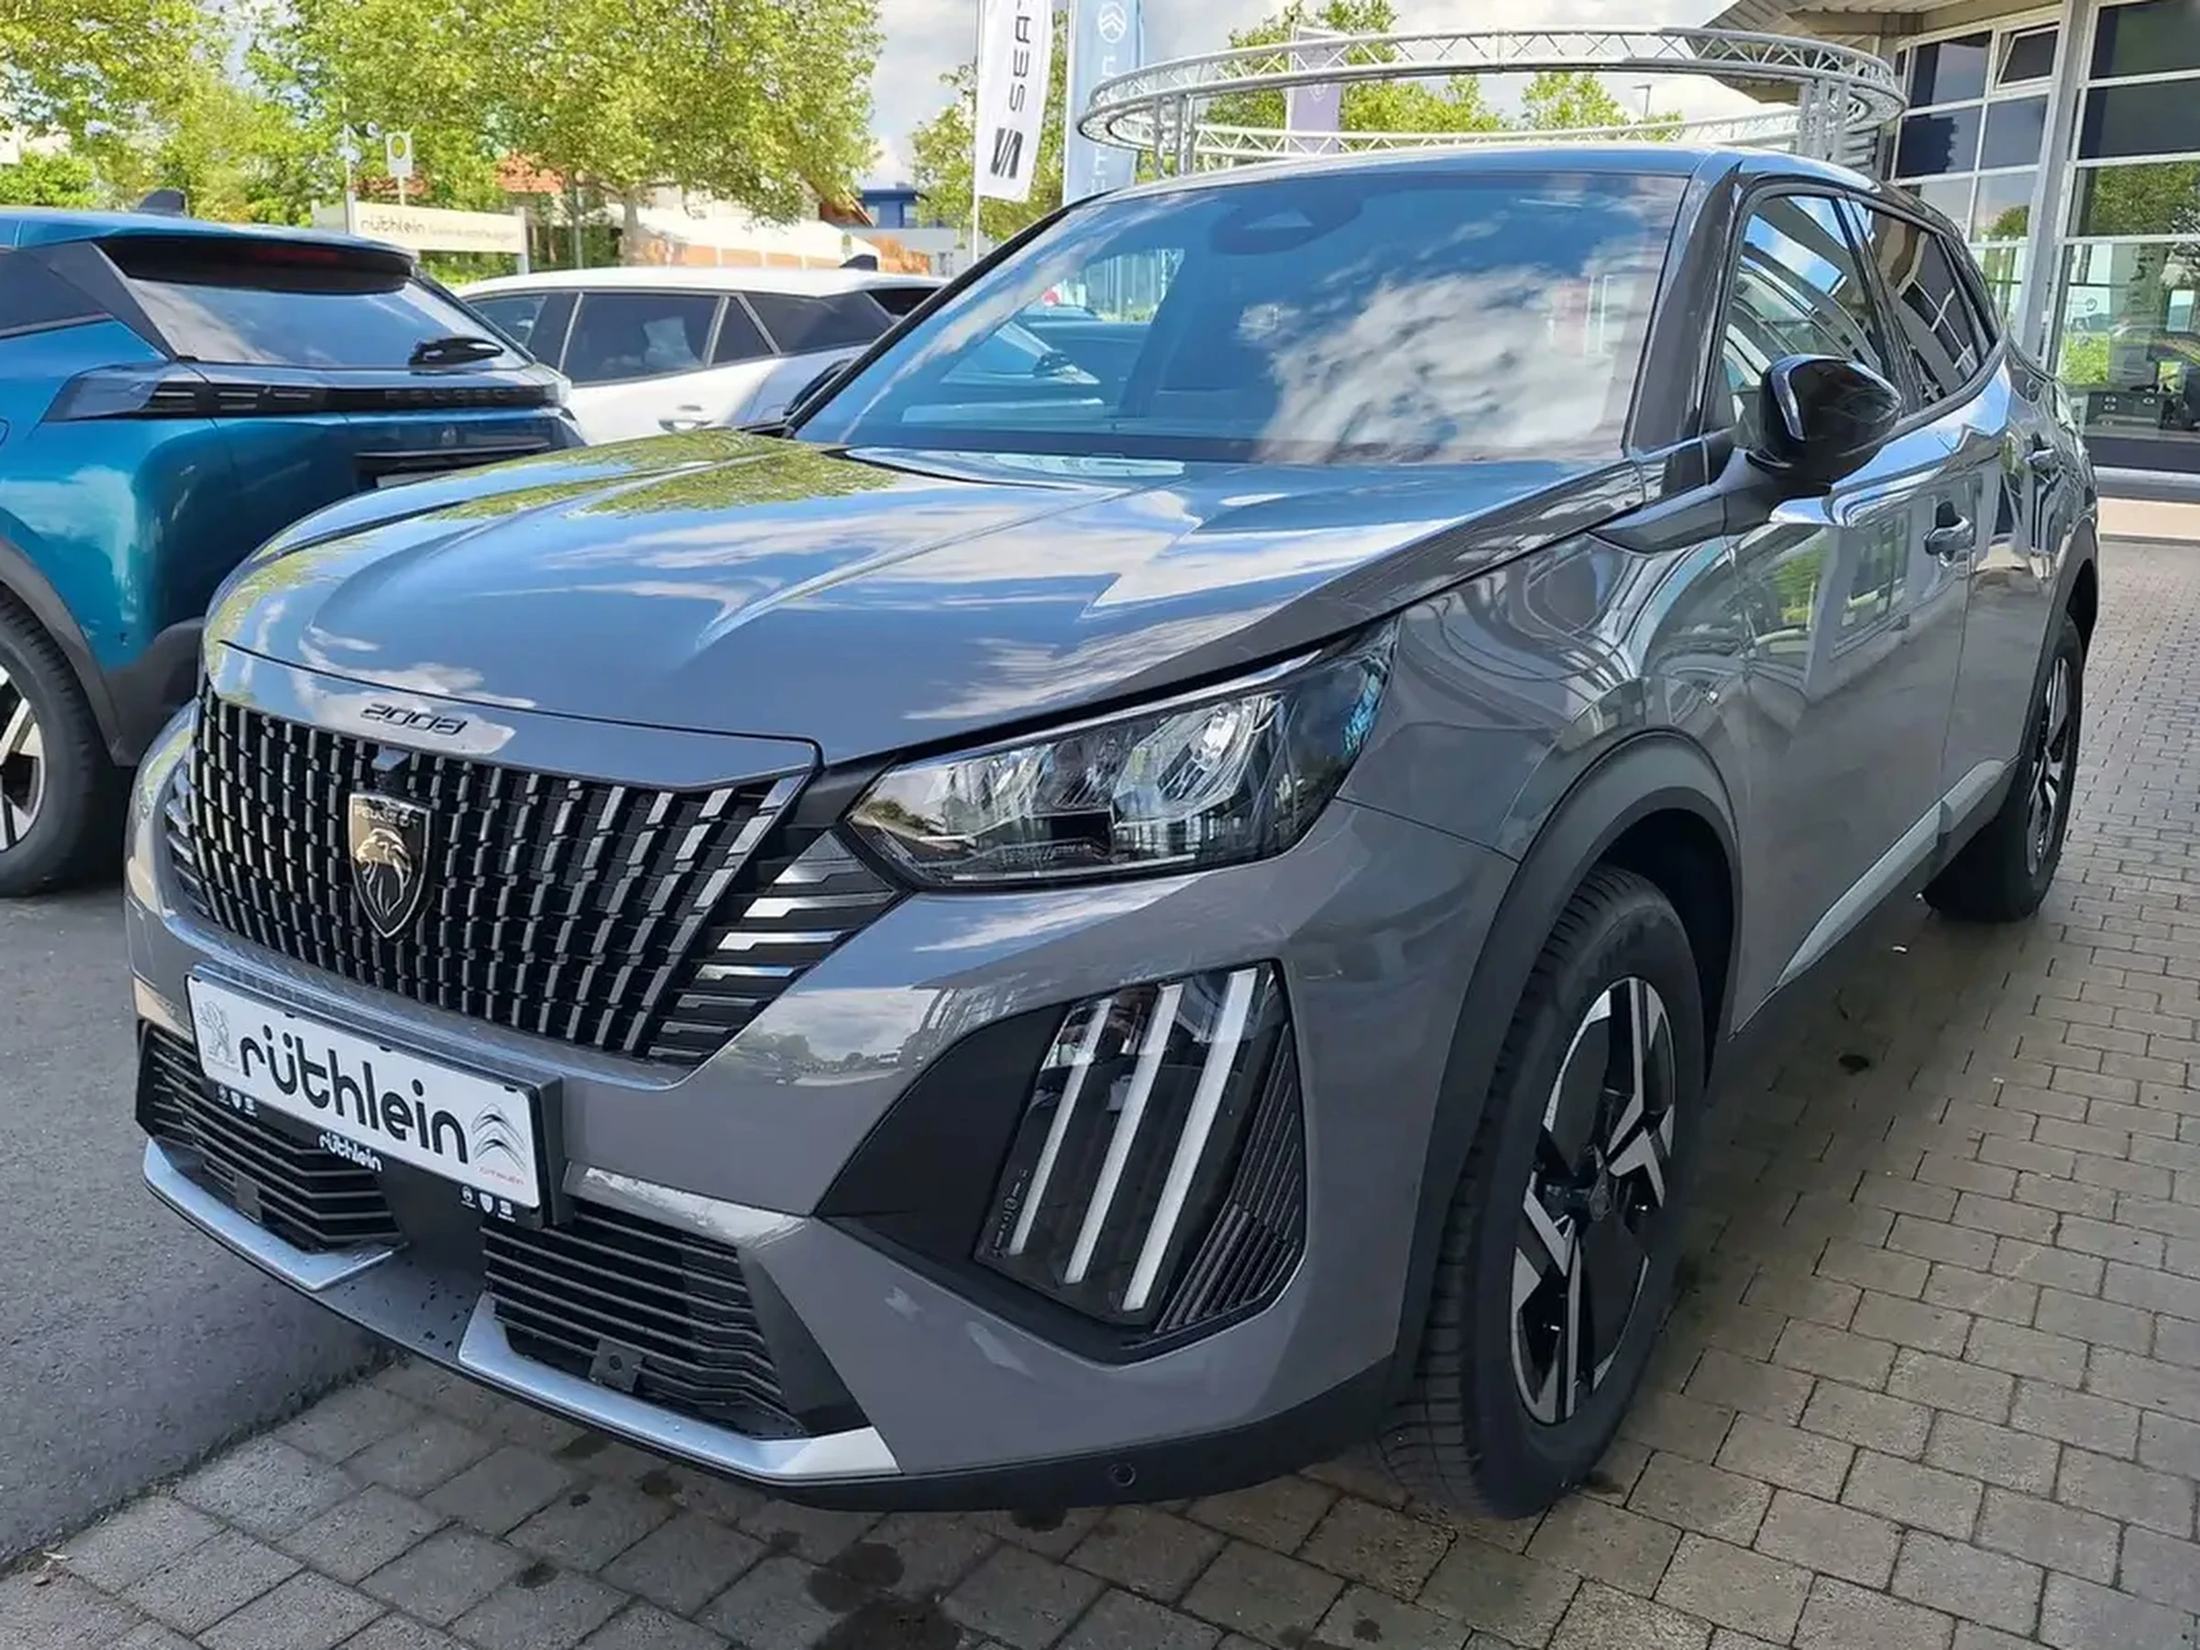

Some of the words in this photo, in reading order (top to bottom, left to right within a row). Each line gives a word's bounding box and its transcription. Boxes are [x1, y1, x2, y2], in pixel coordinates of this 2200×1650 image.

[361, 702, 469, 736] 2008
[239, 1024, 469, 1165] rüthlein
[319, 1131, 383, 1173] rüthlein
